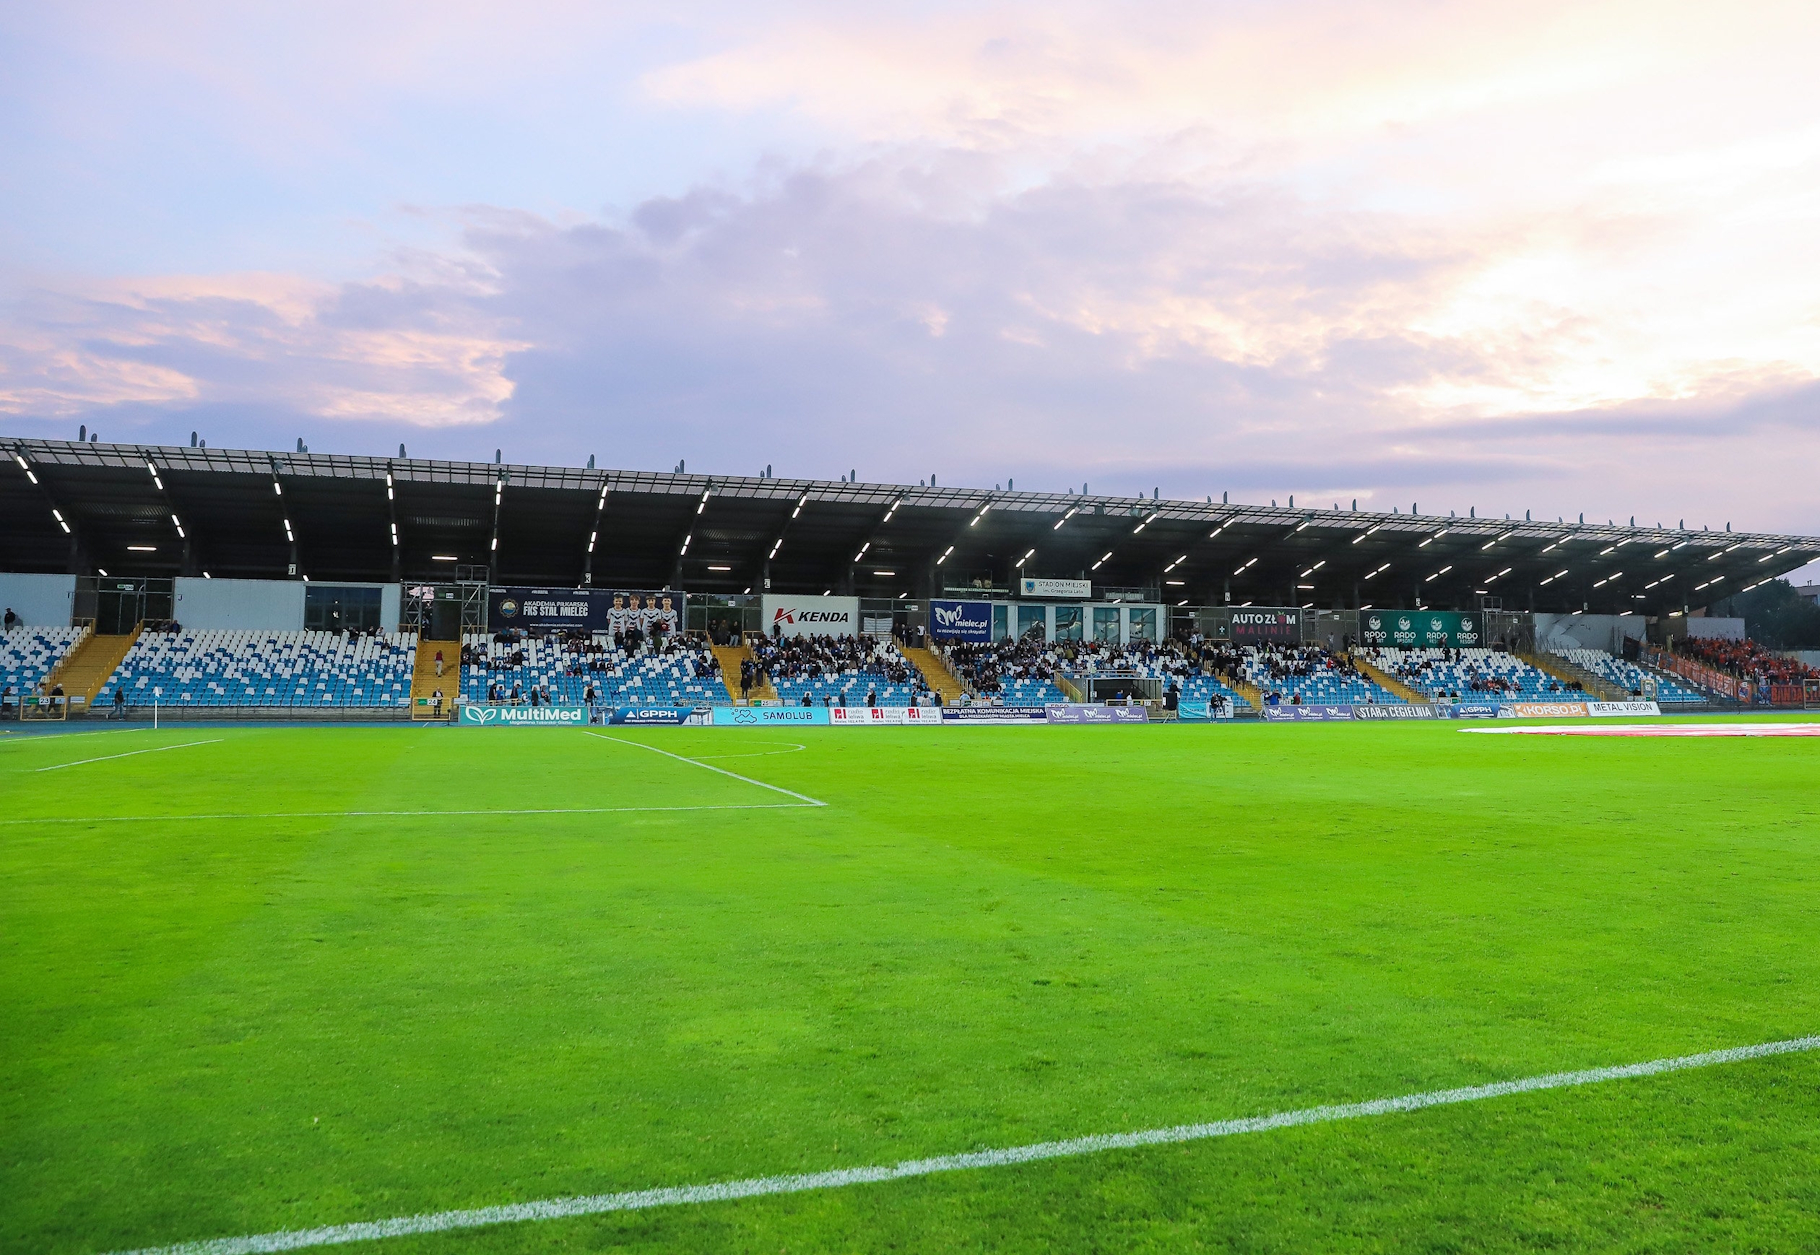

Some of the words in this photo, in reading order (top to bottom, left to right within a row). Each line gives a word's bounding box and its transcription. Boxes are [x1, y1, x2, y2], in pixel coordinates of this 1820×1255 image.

[523, 607, 538, 616] FKS
[540, 607, 558, 616] STAL
[560, 607, 588, 616] MIELEC
[798, 612, 848, 622] KENDA
[955, 619, 988, 629] mielec.pl
[1236, 626, 1291, 634] MALINIE
[501, 708, 581, 720] MultiMed
[1360, 707, 1388, 717] STARA
[1389, 706, 1432, 717] CEGIELNIA
[1527, 704, 1586, 715] KORSO.PL
